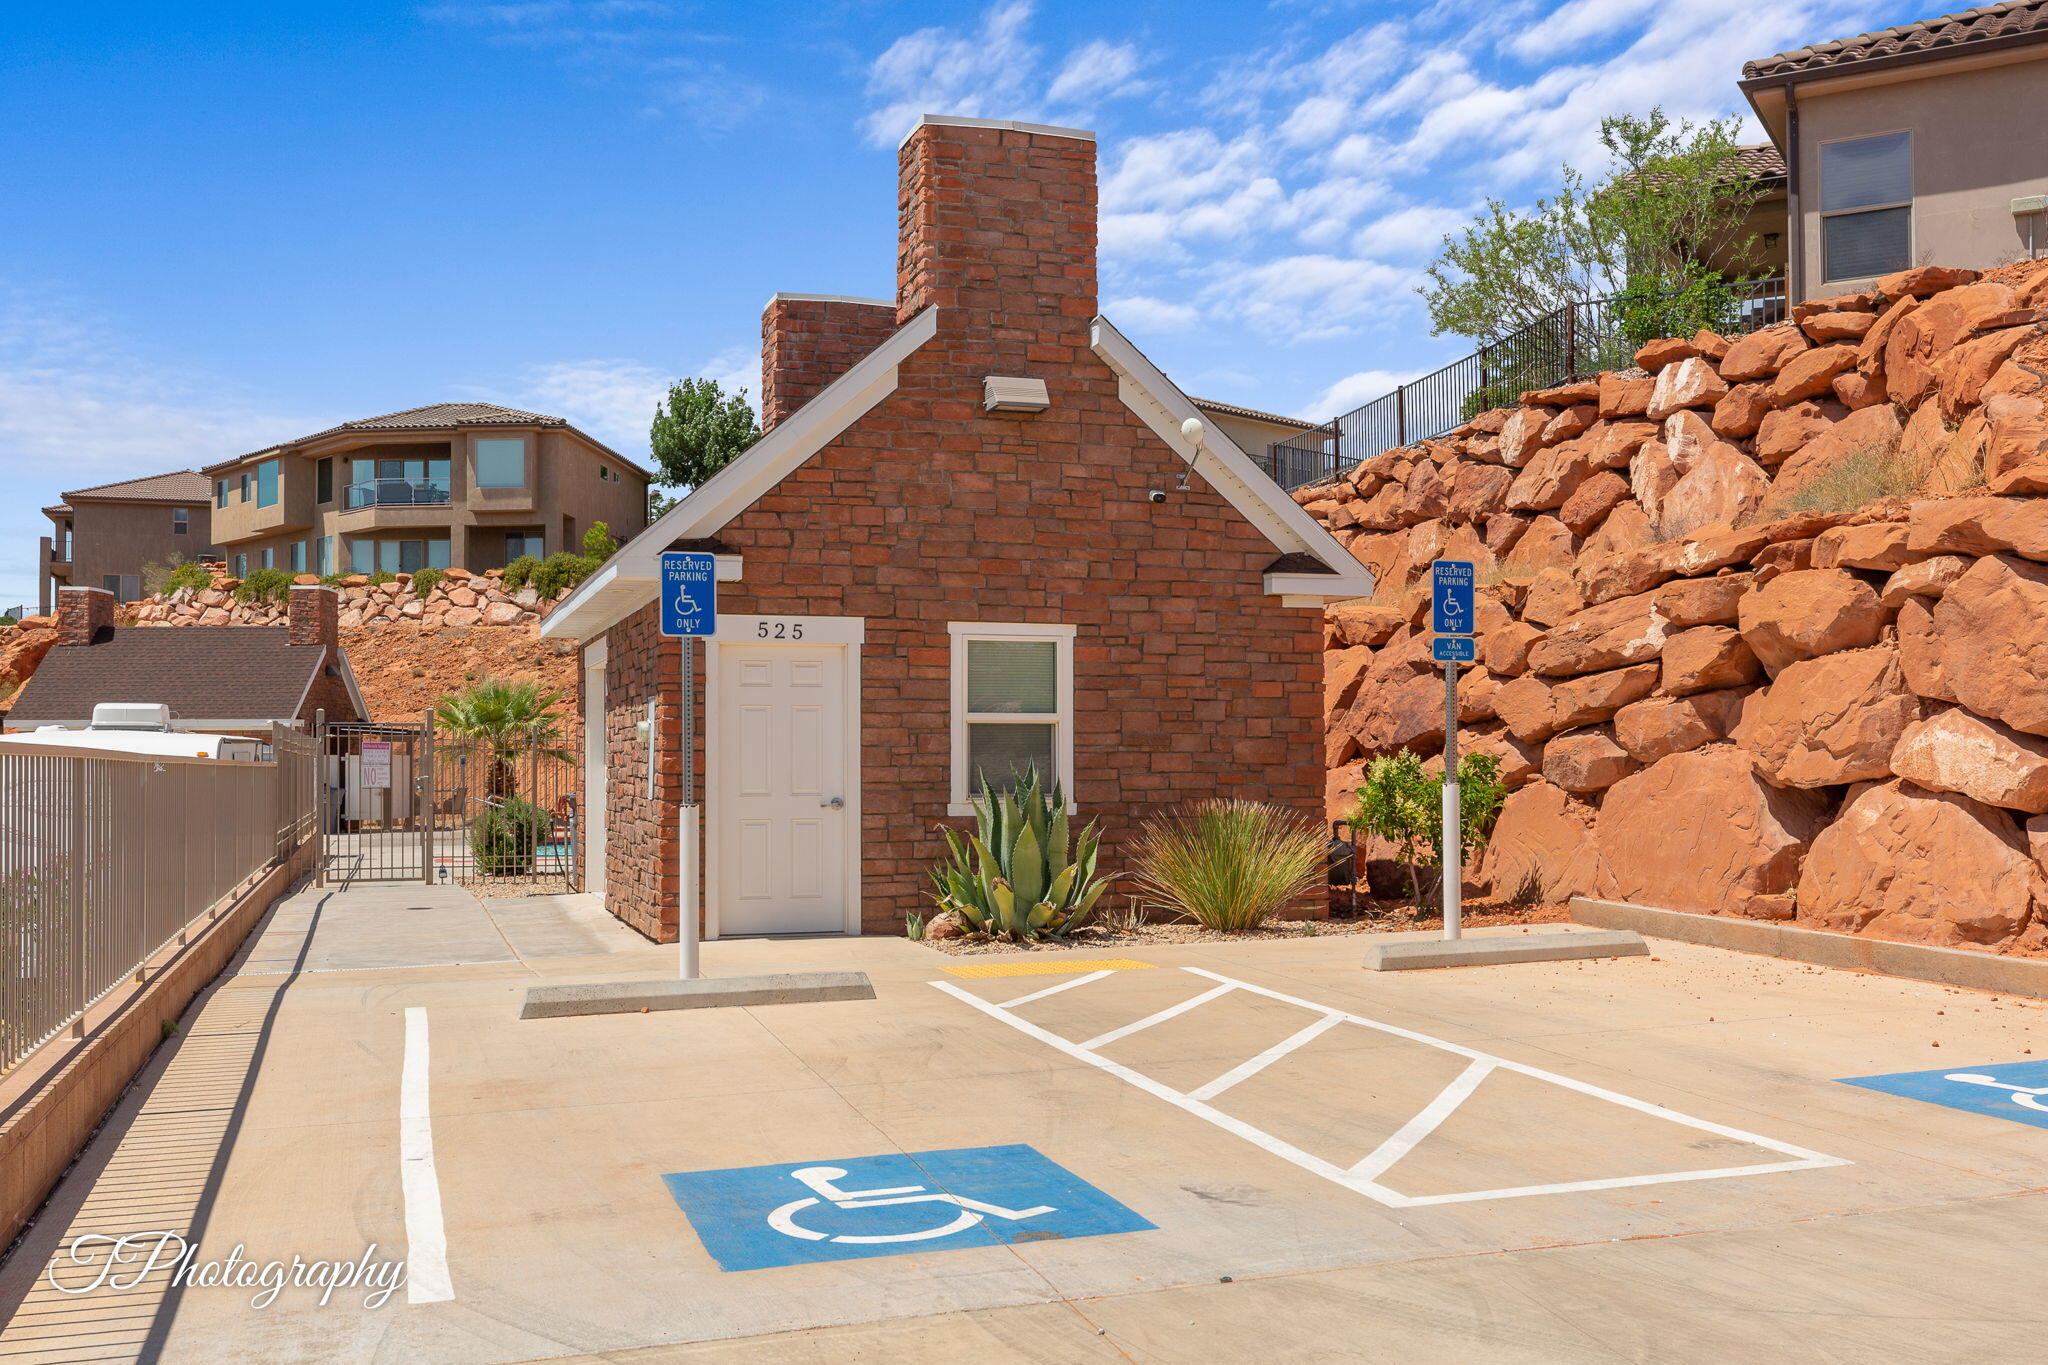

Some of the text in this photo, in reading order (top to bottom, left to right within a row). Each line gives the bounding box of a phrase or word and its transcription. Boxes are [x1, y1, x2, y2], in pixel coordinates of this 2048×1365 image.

[664, 560, 712, 571] RESERVED
[669, 571, 708, 581] PARKING
[1435, 567, 1472, 577] RESERVED
[1438, 577, 1469, 586] PARKING
[676, 618, 700, 628] ONLY
[1444, 618, 1463, 628] ONLY
[758, 622, 803, 640] 525
[1446, 642, 1462, 650] VAN
[363, 767, 377, 786] NO
